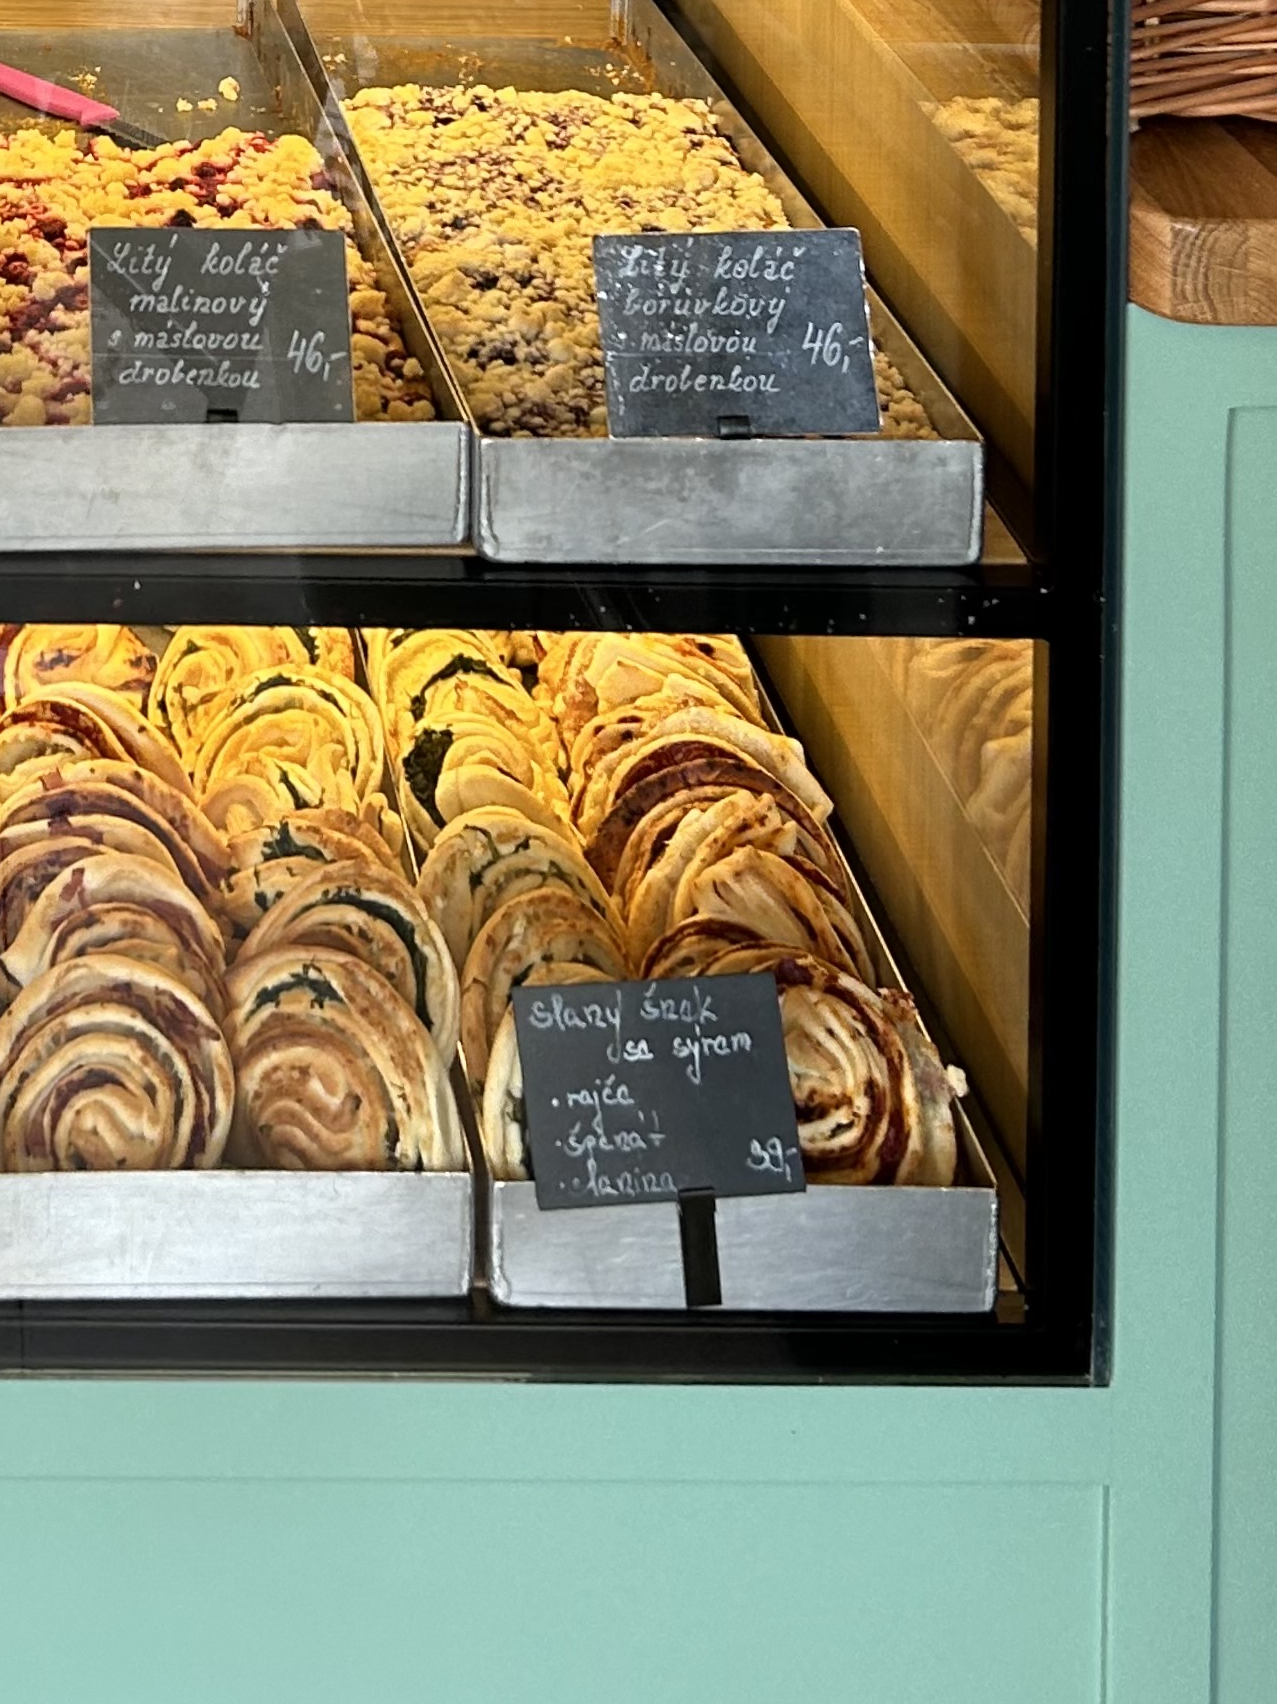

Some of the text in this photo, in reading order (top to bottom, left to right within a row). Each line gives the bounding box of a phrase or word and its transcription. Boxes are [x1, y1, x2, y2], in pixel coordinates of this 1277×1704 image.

[106, 232, 289, 293] Litý koláč
[713, 244, 807, 282] koláč
[107, 329, 123, 348] s
[133, 318, 264, 351] máslovou
[118, 358, 262, 390] drobenkou
[628, 362, 782, 394] drobenkou
